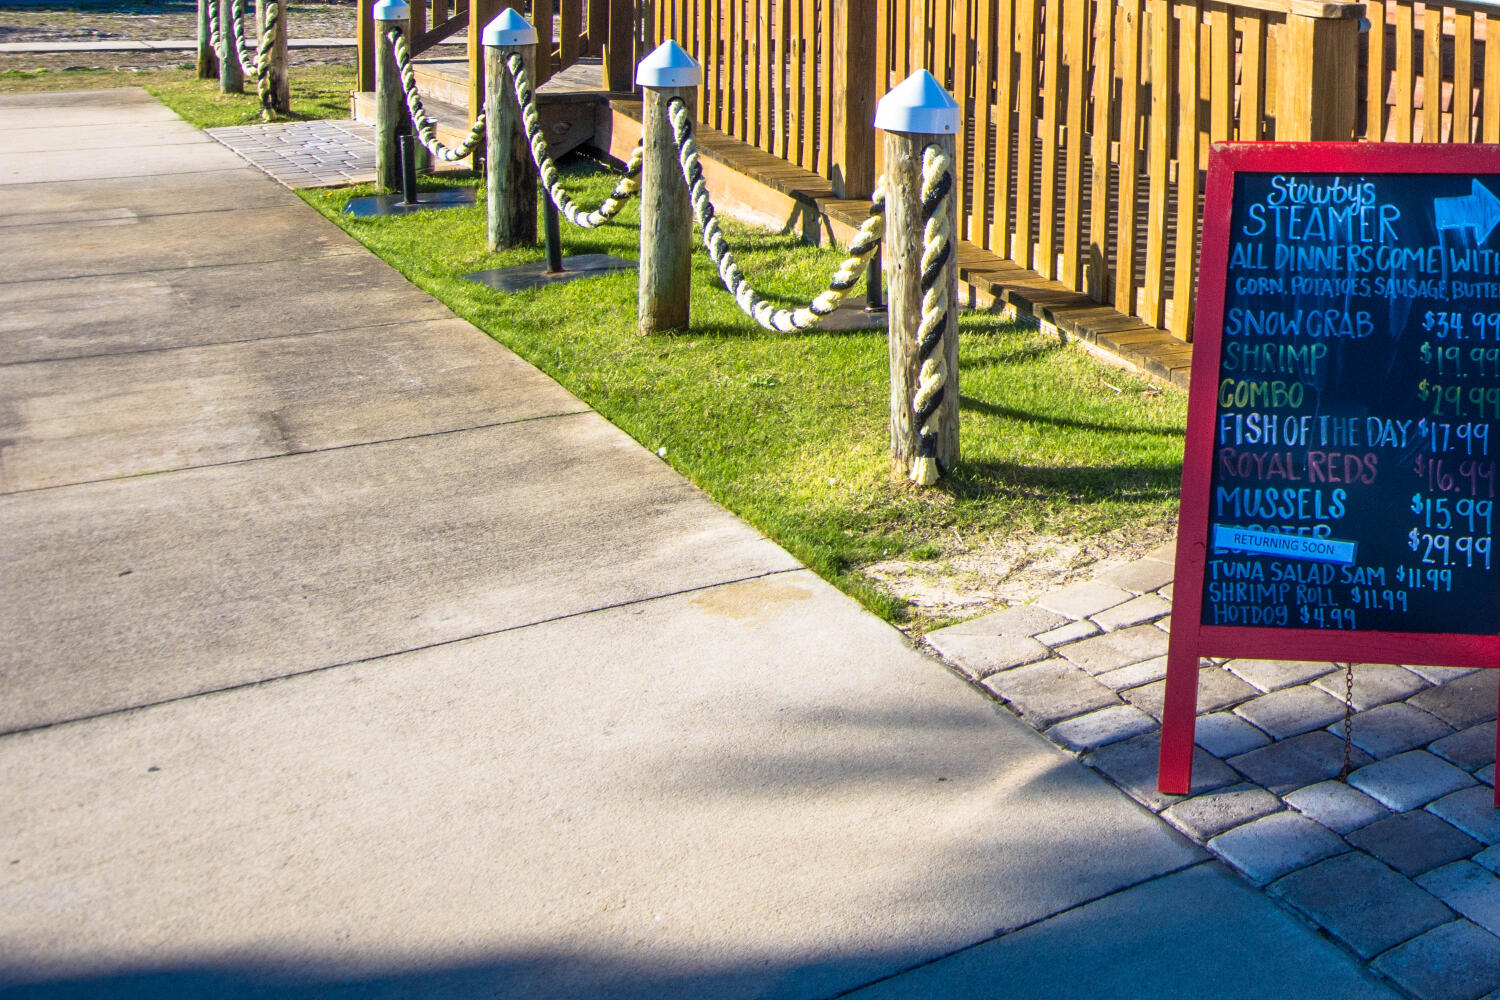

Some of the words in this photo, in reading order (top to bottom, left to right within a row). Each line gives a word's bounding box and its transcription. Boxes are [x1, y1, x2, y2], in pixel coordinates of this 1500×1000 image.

[1267, 175, 1376, 216] Stewby's
[1243, 203, 1400, 243] STEAMER
[1229, 242, 1268, 270] ALL
[1274, 243, 1374, 273] DINNERS
[1376, 245, 1441, 274] COME
[1225, 308, 1303, 336] SNOW
[1306, 309, 1374, 339] CRAB
[1223, 341, 1328, 375] SHRIMP
[1420, 341, 1500, 378] $19.99
[1219, 378, 1304, 408] COMBO
[1418, 379, 1500, 419] $29.99
[1220, 412, 1277, 446] FISH
[1283, 415, 1313, 447] OF
[1318, 415, 1360, 447] THE
[1366, 416, 1413, 448] DAY
[1418, 418, 1489, 455] $17.99
[1219, 447, 1301, 481] ROYAL
[1307, 450, 1378, 484] REDS
[1413, 453, 1495, 498] $16.99
[1216, 486, 1347, 520] MUSSELS
[1410, 493, 1493, 534] $15.99
[1233, 533, 1299, 552] RETURNING
[1302, 541, 1335, 556] SOON
[1408, 527, 1491, 571] $29.99
[1208, 560, 1265, 582] TUNA
[1270, 562, 1335, 585] SALAD
[1396, 564, 1452, 592] $11.99
[1208, 582, 1290, 605] SHRIMP
[1296, 583, 1339, 607] ROLL
[1351, 586, 1408, 612] $11.99
[1300, 605, 1356, 630] $4.99
